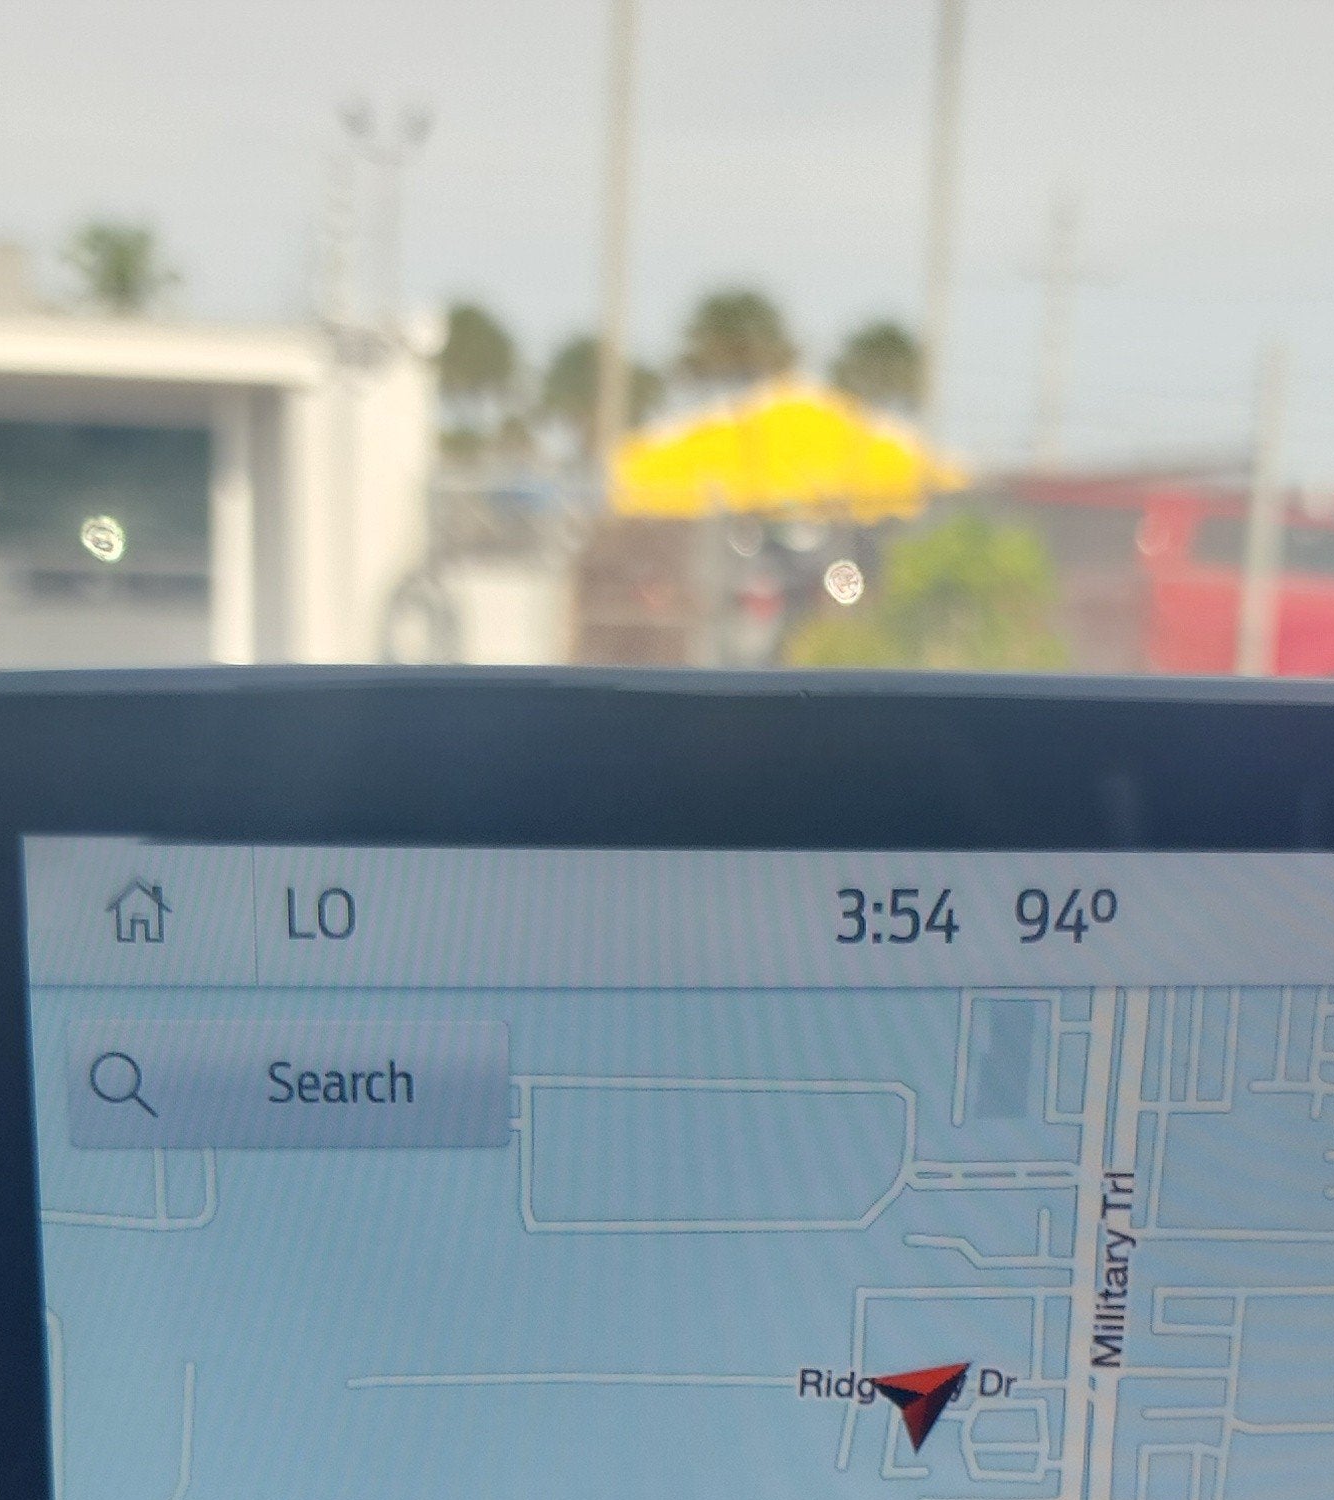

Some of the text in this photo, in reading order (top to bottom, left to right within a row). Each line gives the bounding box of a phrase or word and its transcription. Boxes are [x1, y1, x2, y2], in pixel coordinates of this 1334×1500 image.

[286, 886, 357, 941] LO
[835, 888, 959, 944] 3:54
[268, 1060, 414, 1104] Search
[1090, 1171, 1137, 1368] Military Trl
[979, 1369, 1017, 1398] Dr
